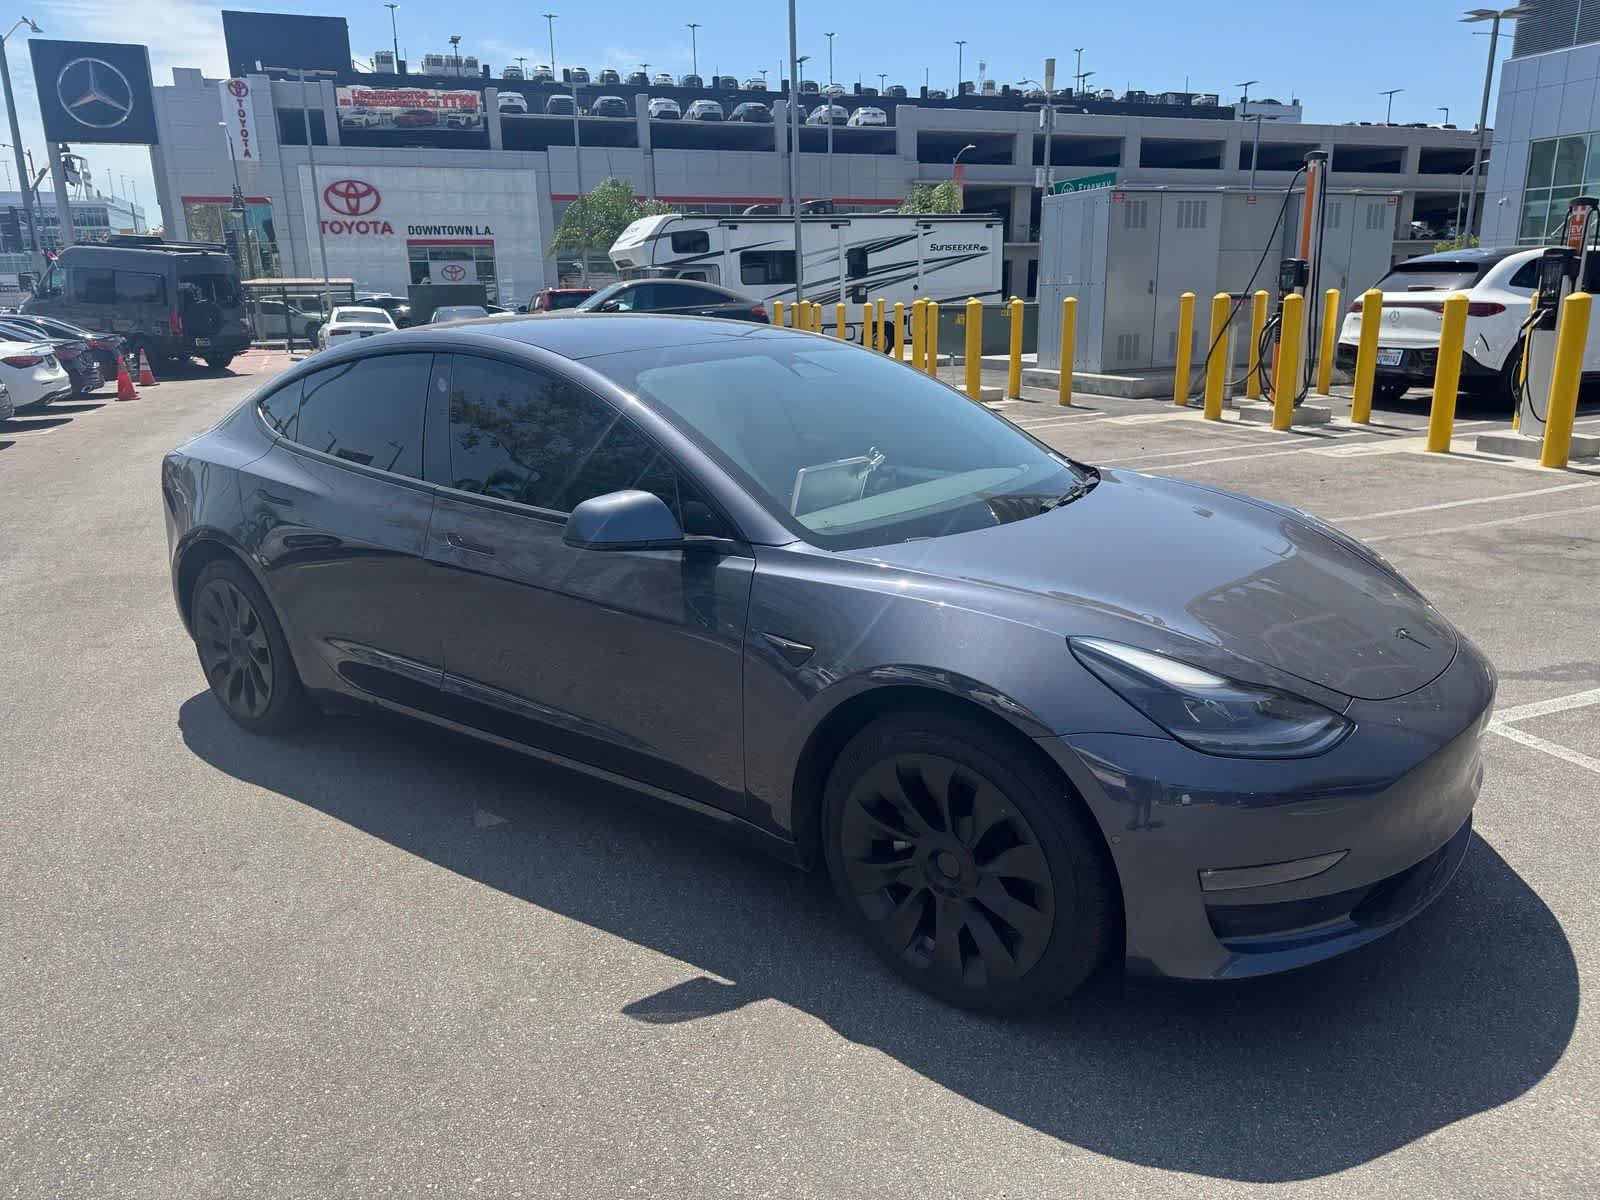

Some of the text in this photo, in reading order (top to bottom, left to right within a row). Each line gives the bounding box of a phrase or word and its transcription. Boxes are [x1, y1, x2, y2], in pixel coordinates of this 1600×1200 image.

[236, 98, 252, 158] TOYOTA
[320, 220, 394, 235] TOYOTA
[407, 225, 495, 236] DOWNTOWN L.A.
[929, 243, 980, 252] SUNSEEKER
